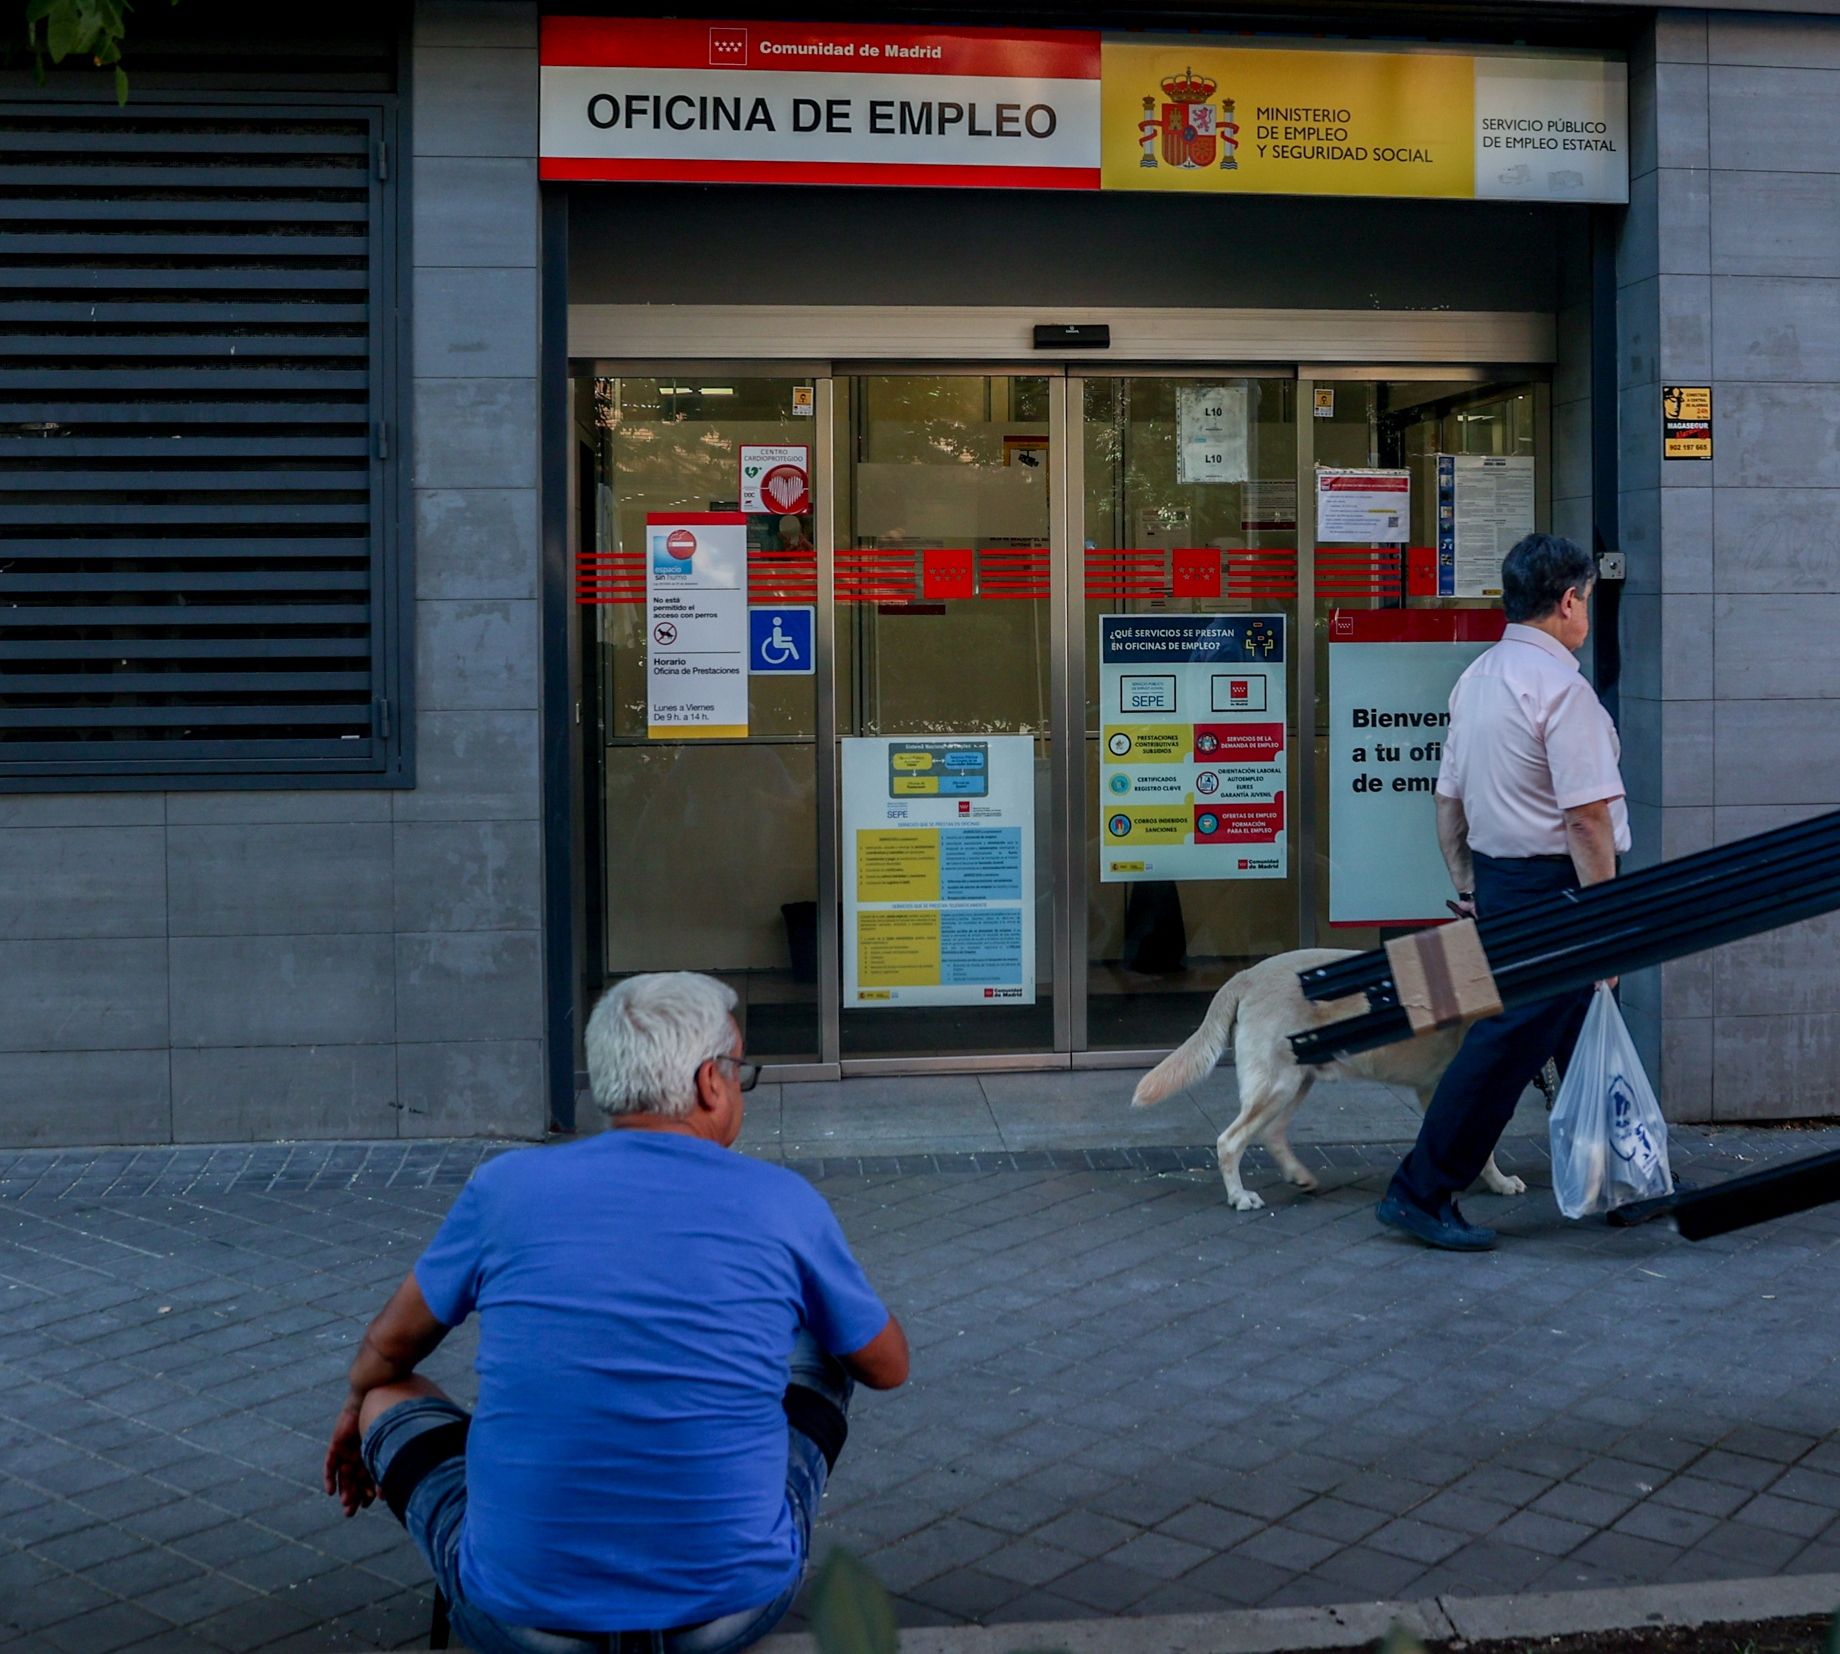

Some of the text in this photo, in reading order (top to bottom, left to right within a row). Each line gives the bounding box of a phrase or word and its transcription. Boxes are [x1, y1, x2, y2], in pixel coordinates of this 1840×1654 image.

[759, 41, 942, 60] Comunidad de Madrid
[586, 93, 1058, 139] OFICINA DE EMPLEO
[1256, 107, 1351, 124] MINISTERIO
[1482, 117, 1606, 134] SERVICIO PÚBLICO
[1256, 126, 1348, 142] DE EMPLEO
[1482, 137, 1616, 152] DE EMPLEO ESTATAL
[1256, 145, 1432, 163] Y SEGURIDAD SOCIAL
[1205, 408, 1222, 416] L10
[1205, 455, 1222, 464] L10
[1110, 628, 1133, 640] ¿QUÉ
[654, 658, 686, 666] Horario
[654, 667, 680, 675] Oficina
[692, 667, 740, 675] Prestaciones
[1132, 696, 1164, 707] SEPE
[1352, 747, 1366, 762] a
[1376, 744, 1400, 762] tu
[1352, 774, 1382, 793] de
